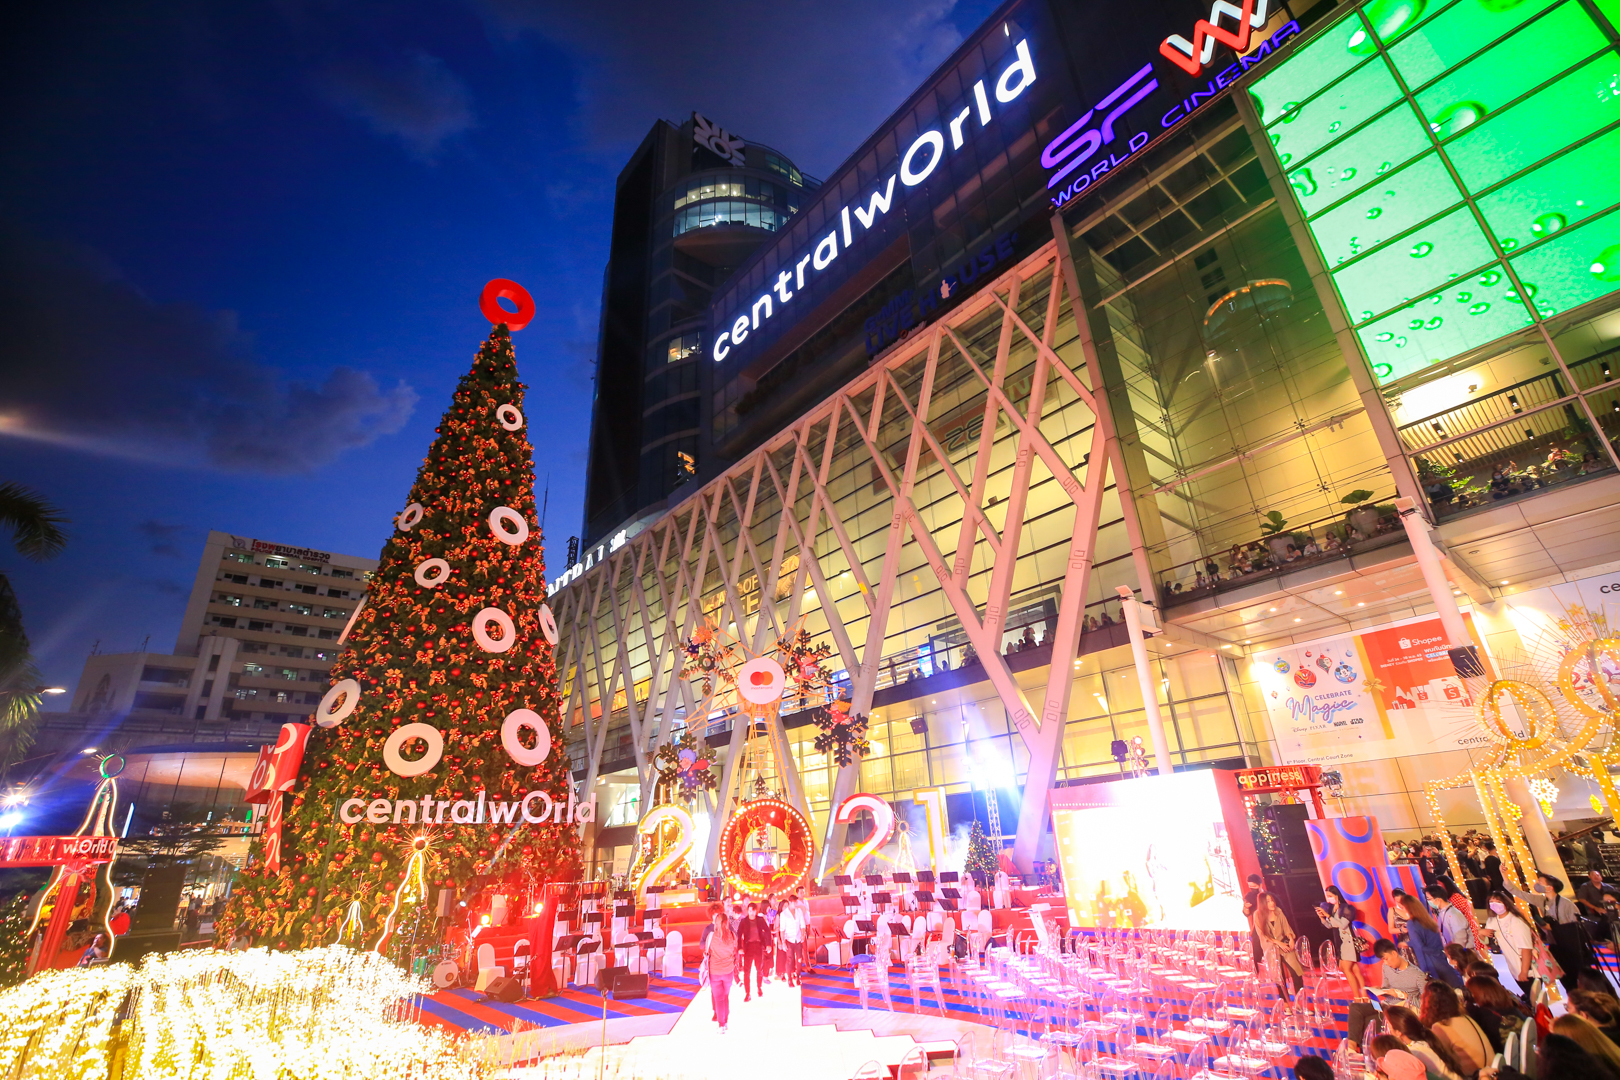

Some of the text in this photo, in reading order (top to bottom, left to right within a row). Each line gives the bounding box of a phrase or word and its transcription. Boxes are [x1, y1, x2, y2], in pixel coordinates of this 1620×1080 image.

[1051, 19, 1302, 208] WORLD CINEMA
[1040, 62, 1159, 189] SF
[713, 38, 1037, 362] centralwOrld
[250, 547, 330, 564] POLICE GENERAL HOSPITAL
[252, 539, 330, 559] โรงพยาบาลตำรวจ
[1412, 636, 1442, 645] Shopee
[1314, 689, 1352, 701] CELEBRATE
[1285, 694, 1356, 723] Magic
[1238, 769, 1301, 787] appiness
[339, 790, 597, 825] centralwOrld
[63, 839, 108, 855] wOrld
